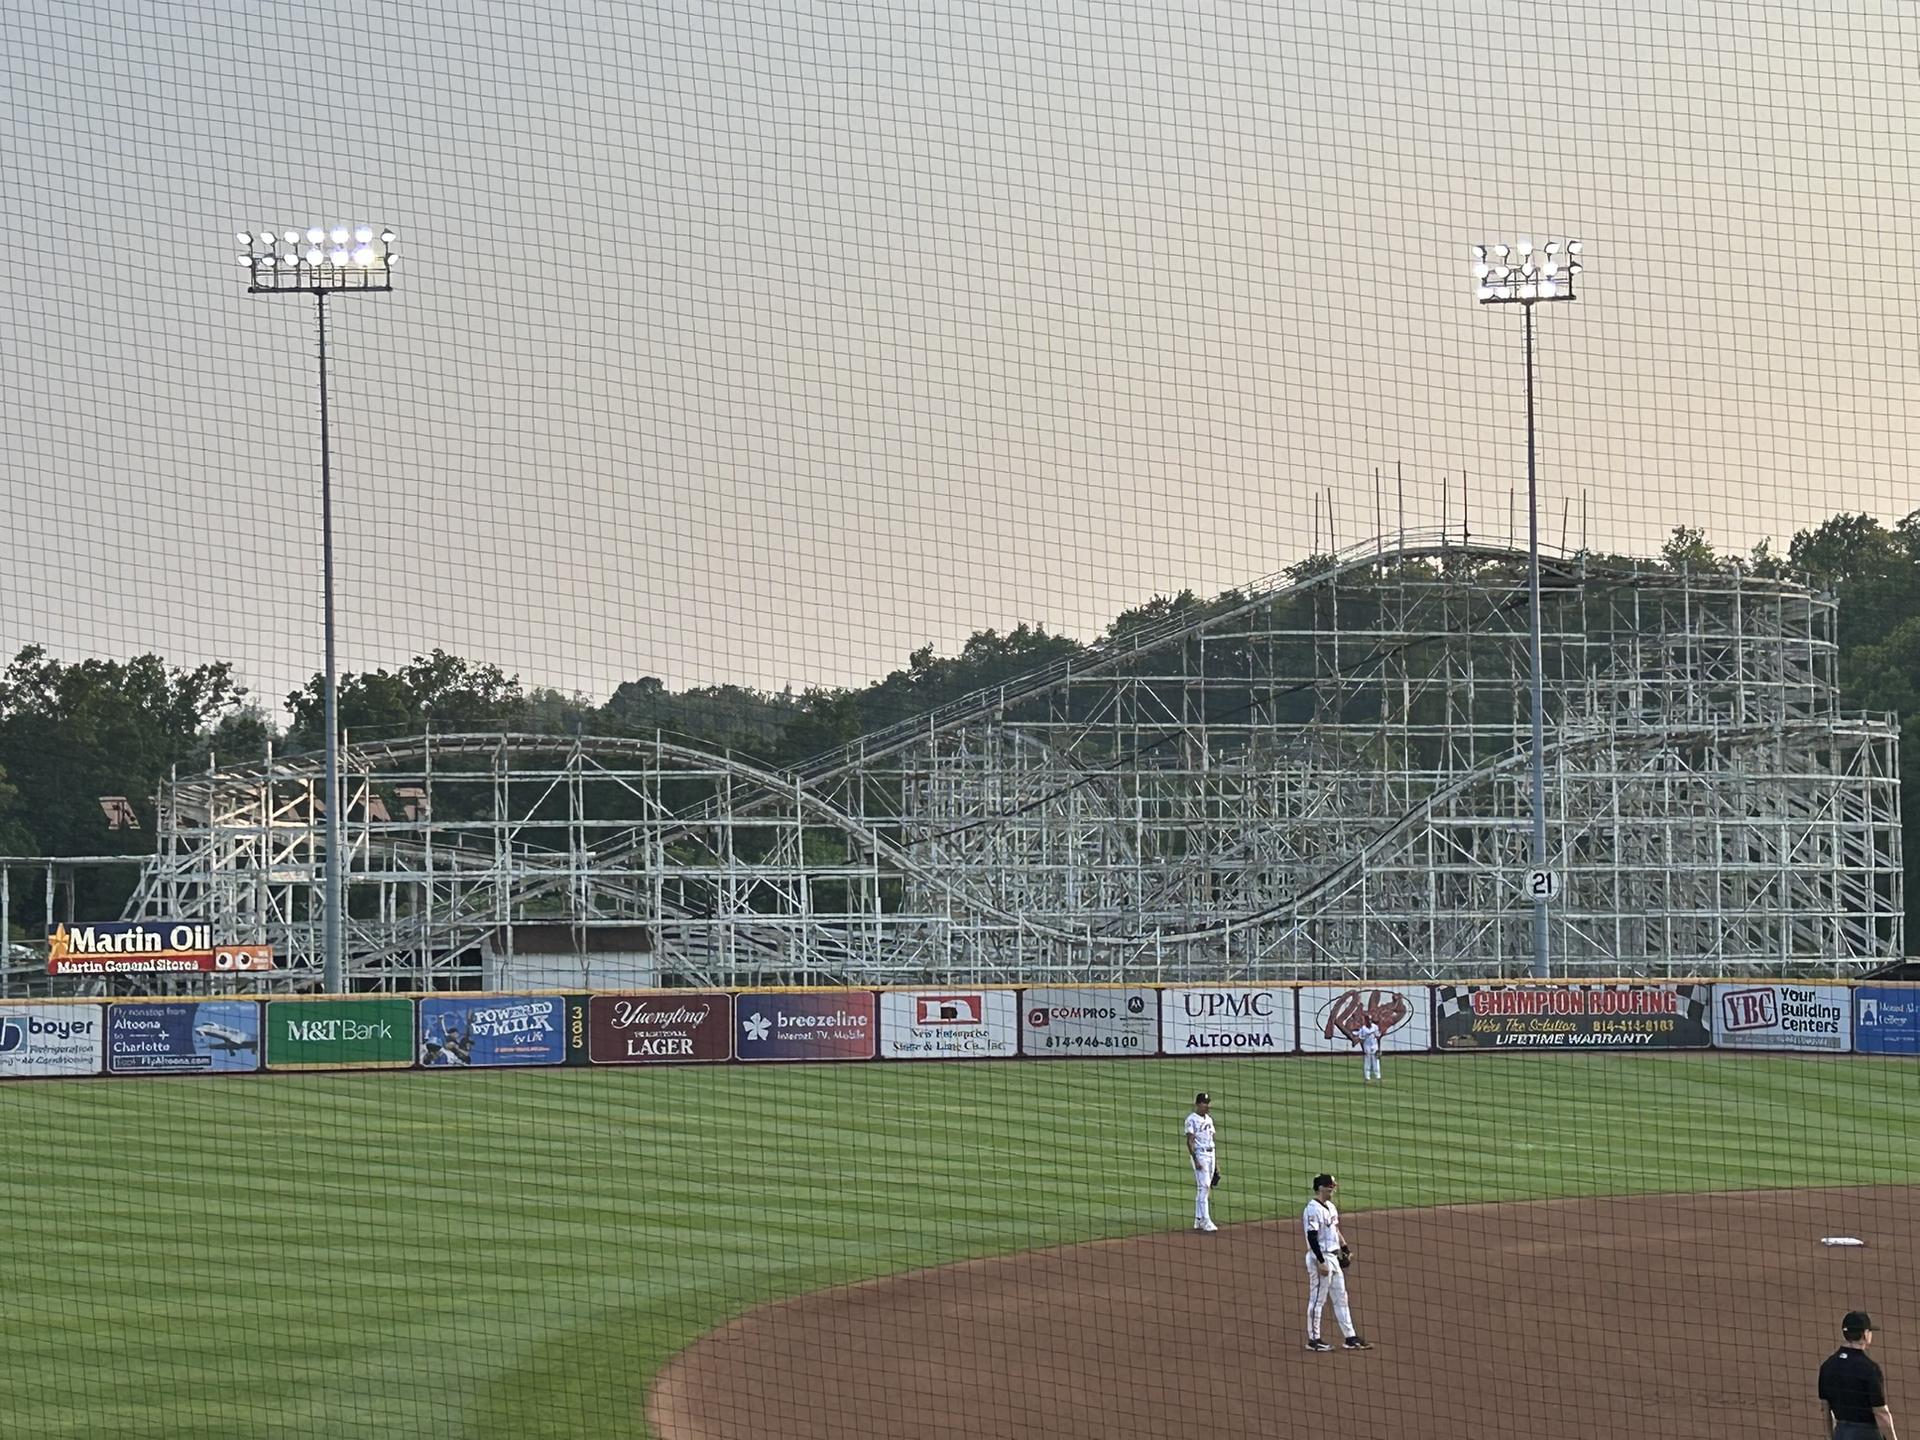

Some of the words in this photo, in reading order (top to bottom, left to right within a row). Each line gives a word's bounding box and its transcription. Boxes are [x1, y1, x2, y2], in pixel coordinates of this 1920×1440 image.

[1533, 872, 1551, 894] 21
[69, 926, 162, 953] Martin
[170, 925, 211, 950] Oil
[57, 960, 104, 973] Martin
[105, 959, 155, 972] General
[156, 960, 198, 971] Stores
[1473, 990, 1584, 1016] CHAMPION
[1588, 989, 1678, 1015] ROOFING
[1781, 988, 1815, 1001] Your
[475, 1001, 552, 1023] POWERED
[1051, 1007, 1117, 1019] COMPROS
[1184, 993, 1273, 1017] UPMC
[1727, 993, 1773, 1026] YBC
[1781, 1003, 1840, 1020] Building
[611, 1001, 710, 1029] Yuengling
[777, 1010, 868, 1027] breezeline
[29, 1017, 93, 1039] boyer
[114, 1019, 161, 1029] Altoona
[287, 1020, 340, 1041] M&T
[342, 1019, 392, 1040] Bank
[471, 1023, 491, 1036] by
[493, 1014, 554, 1036] MILK
[1528, 1018, 1577, 1032] Solution
[1782, 1018, 1839, 1033] Centers
[114, 1042, 170, 1052] Charlotte
[627, 1039, 694, 1056] LAGER
[923, 1041, 932, 1051] &
[1186, 1033, 1274, 1047] ALTOONA
[1496, 1033, 1565, 1045] LIFETIME
[1568, 1033, 1653, 1045] WARRANTY
